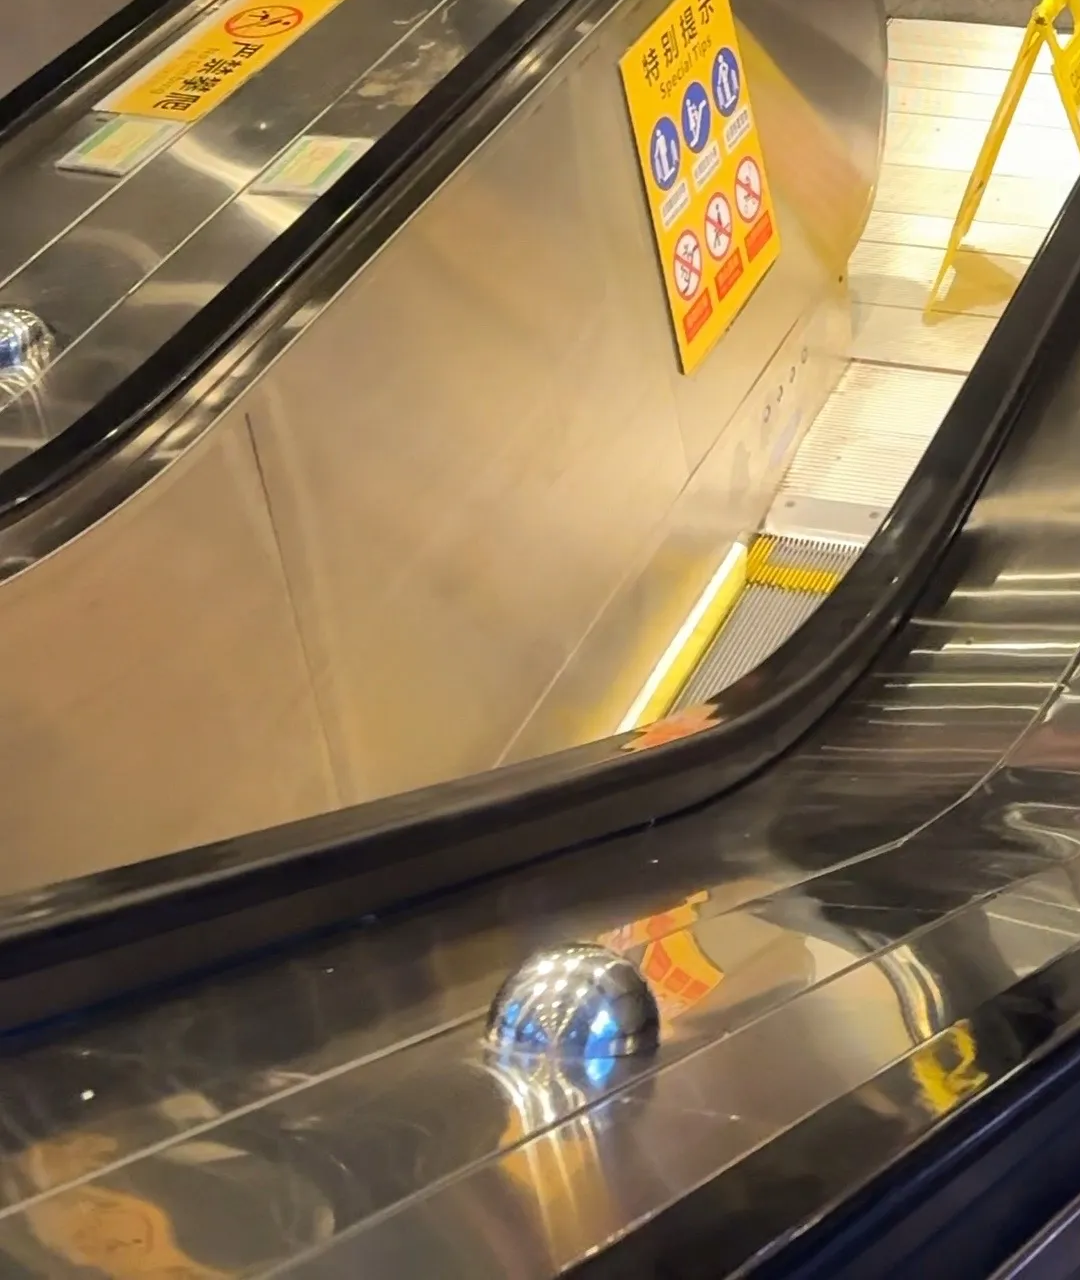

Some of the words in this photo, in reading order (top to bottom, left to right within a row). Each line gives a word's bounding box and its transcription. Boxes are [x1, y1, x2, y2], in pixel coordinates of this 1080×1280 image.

[152, 41, 264, 111] 严禁攀爬
[659, 51, 692, 100] Special
[692, 34, 712, 62] Tips
